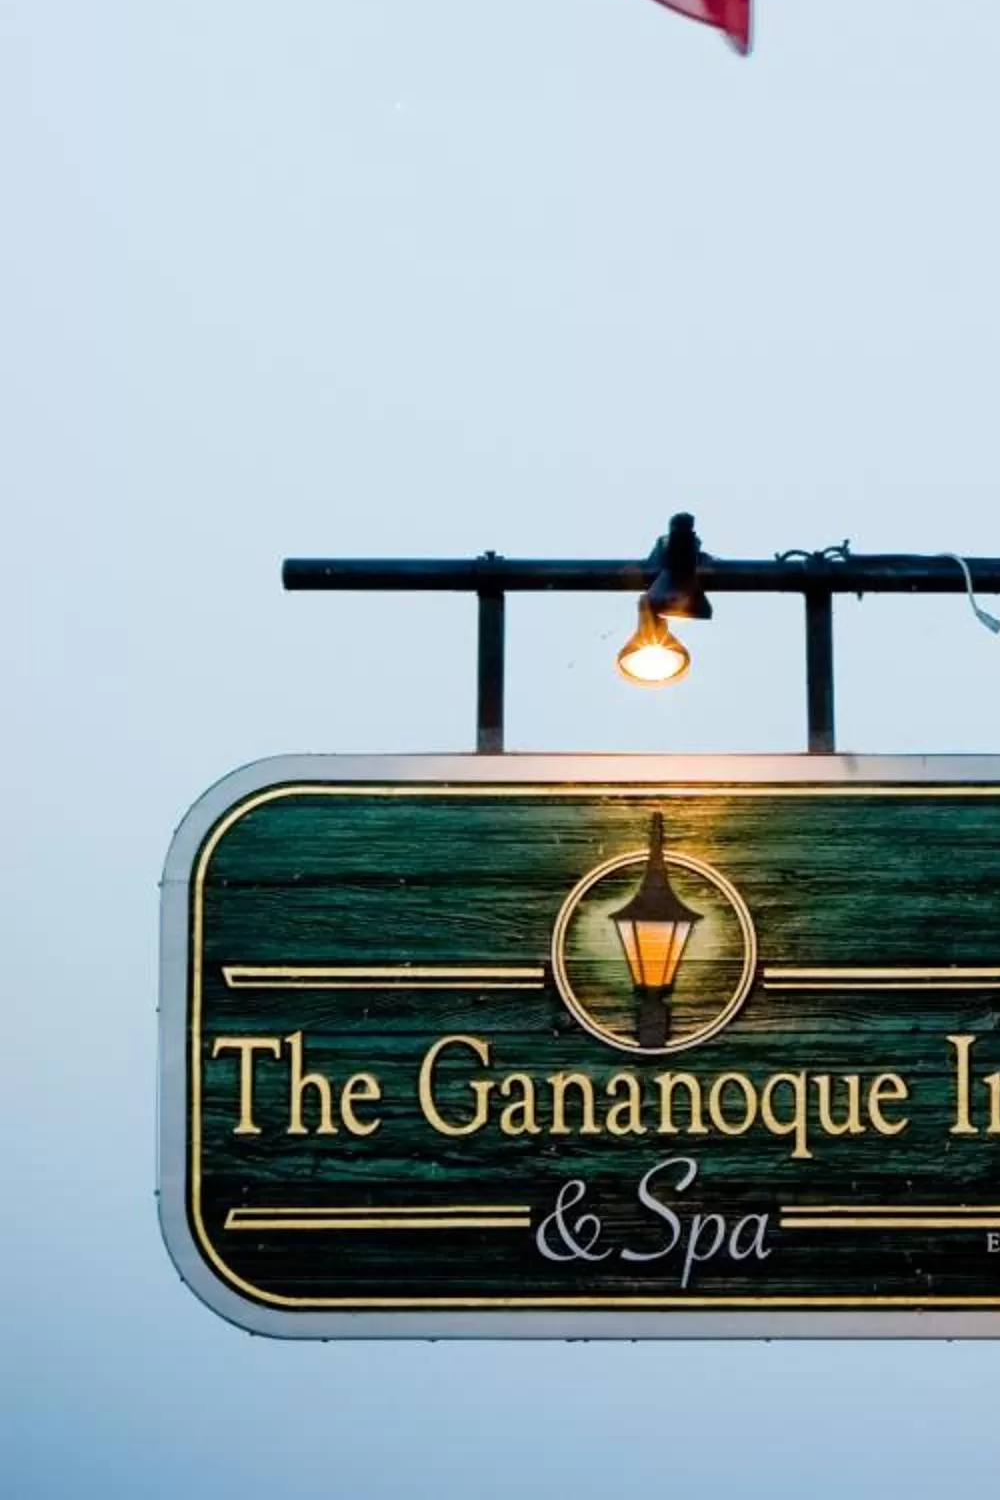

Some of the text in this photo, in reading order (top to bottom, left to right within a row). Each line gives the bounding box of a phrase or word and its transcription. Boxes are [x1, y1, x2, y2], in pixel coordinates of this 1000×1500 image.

[212, 1031, 382, 1136] The
[418, 1035, 909, 1158] Gananoque
[536, 1157, 773, 1288] & Spa
